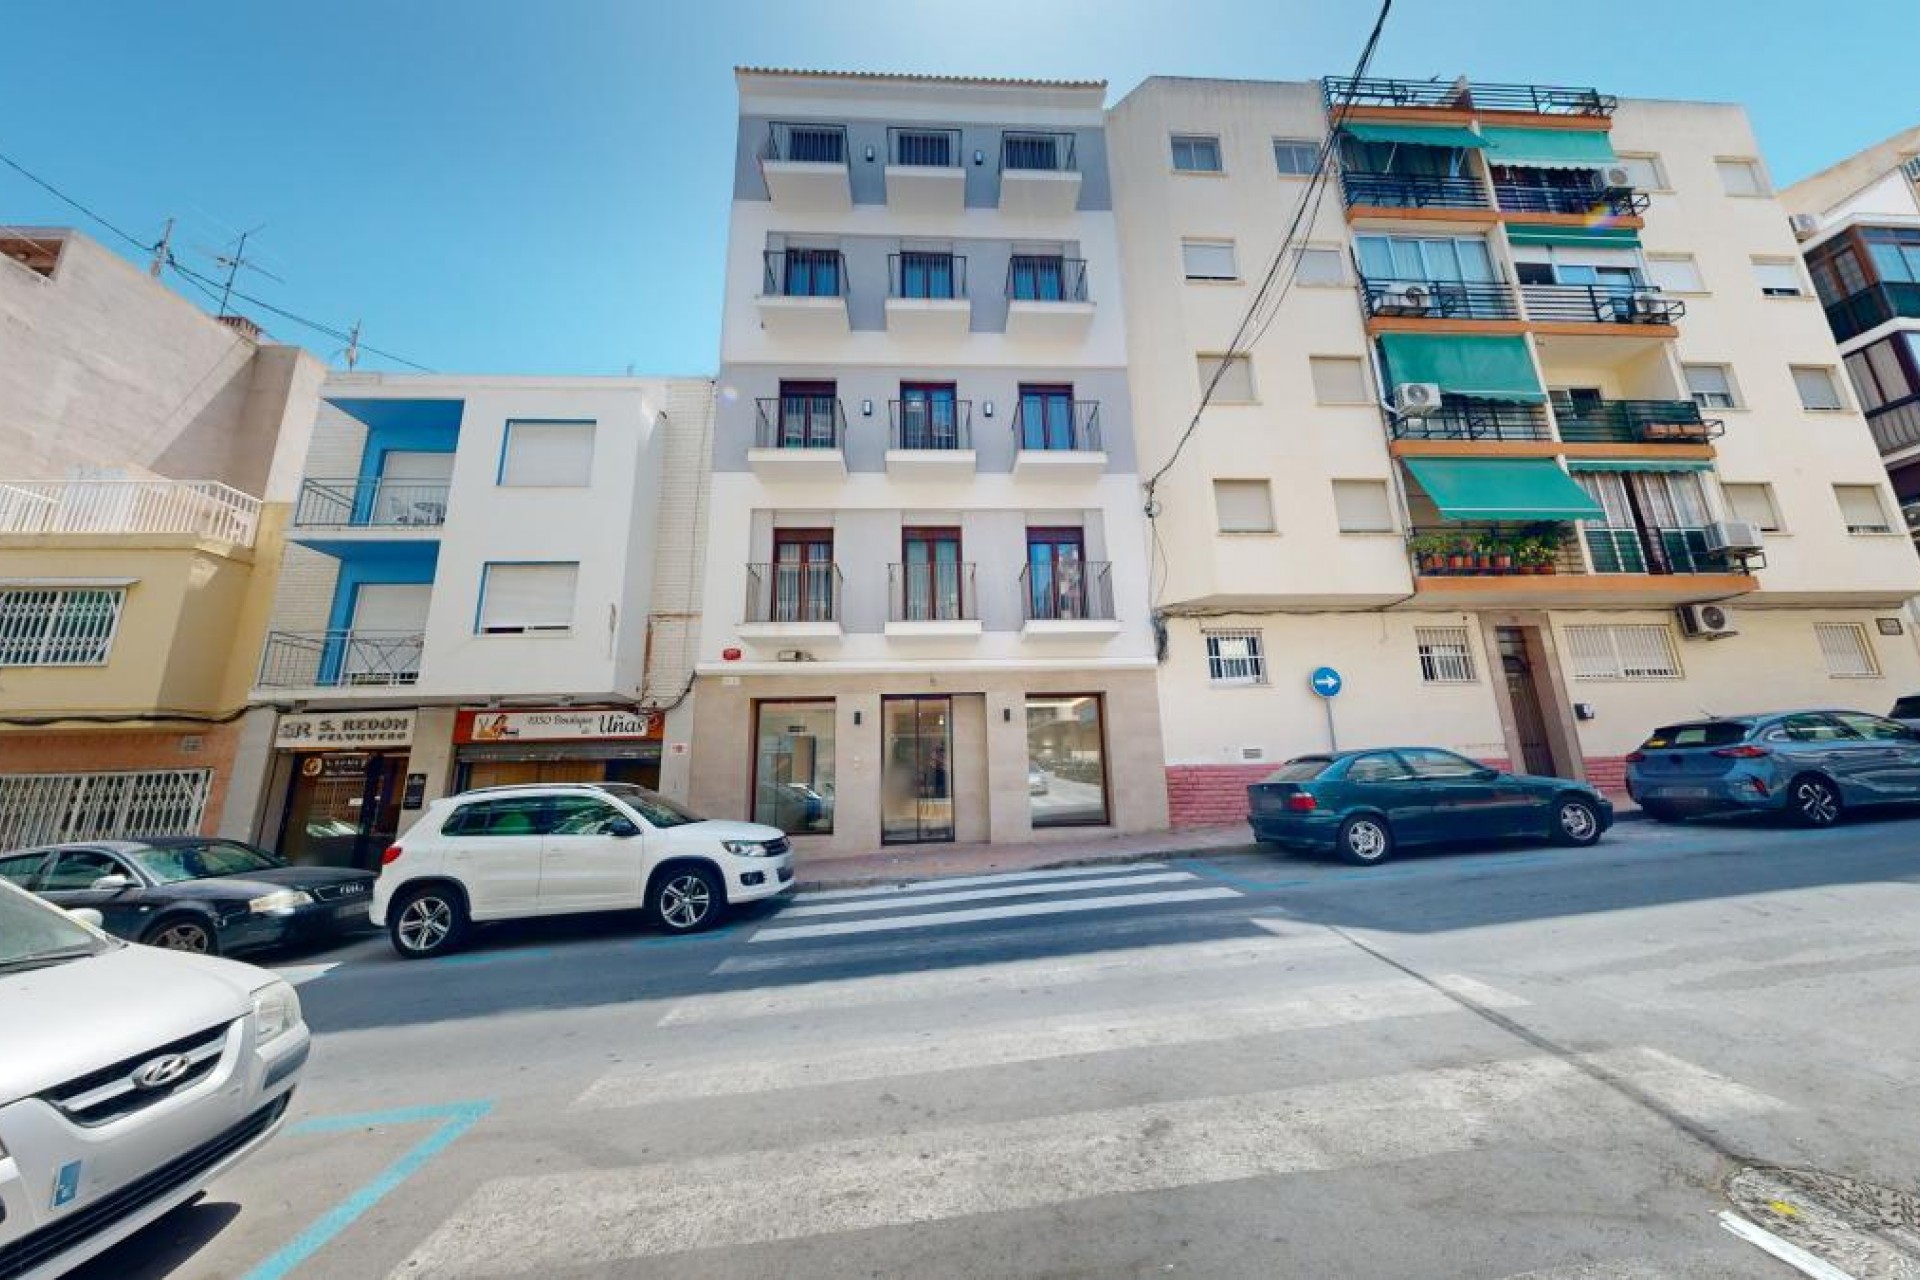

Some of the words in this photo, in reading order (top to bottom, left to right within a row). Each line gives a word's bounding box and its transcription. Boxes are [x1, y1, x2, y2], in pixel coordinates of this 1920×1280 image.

[318, 720, 336, 731] S.
[554, 714, 593, 728] Boutique
[600, 714, 644, 734] Uñas
[317, 732, 406, 741] PELUQUERO
